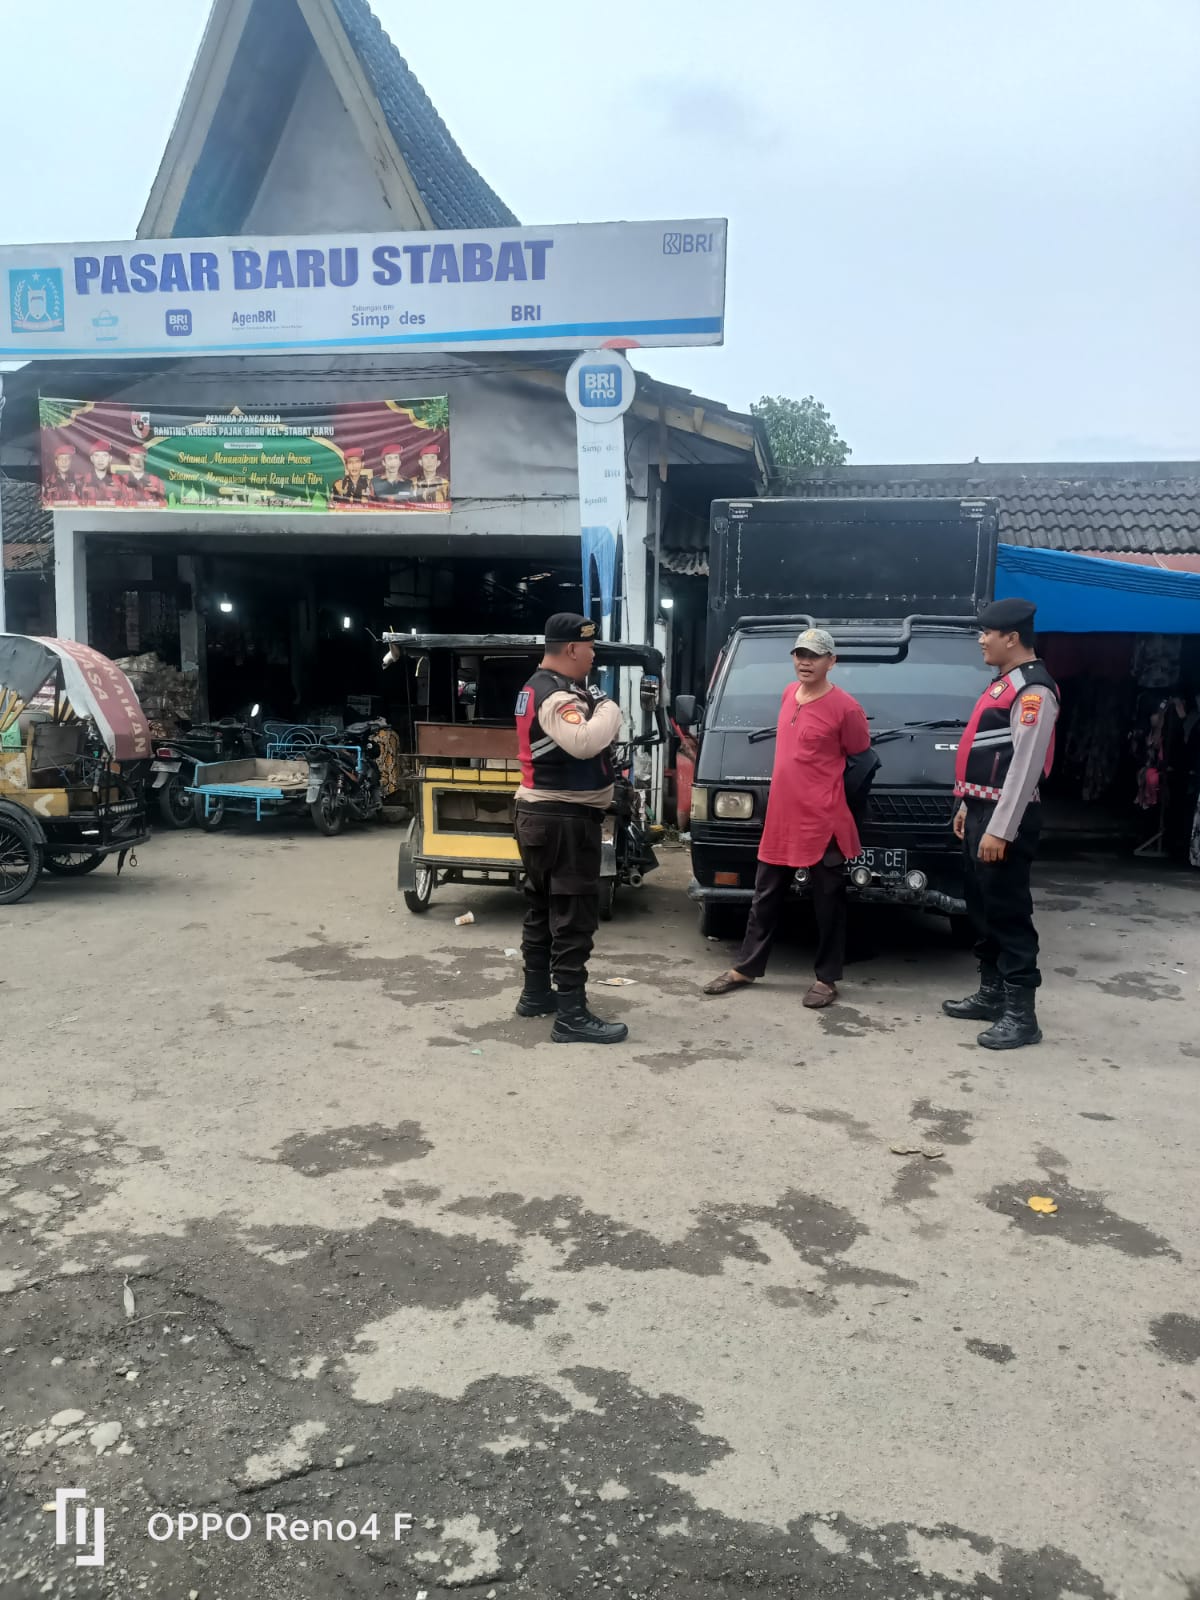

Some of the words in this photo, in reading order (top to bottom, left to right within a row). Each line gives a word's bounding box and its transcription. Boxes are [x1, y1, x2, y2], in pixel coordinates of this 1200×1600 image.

[682, 234, 713, 253] BRI
[74, 252, 220, 295] PASAR
[232, 246, 359, 290] BARU
[372, 240, 554, 286] STABAT
[169, 314, 188, 325] BRI
[232, 310, 276, 327] AgenBRI
[351, 312, 390, 329] Simp
[399, 311, 426, 325] des
[511, 305, 541, 322] BRI
[172, 324, 188, 332] mo
[584, 372, 615, 389] BRI
[590, 389, 616, 399] mo
[205, 414, 236, 423] PEMUDA
[238, 414, 281, 423] PANCASILA
[153, 426, 186, 436] RANTING
[188, 426, 217, 436] KHUSUS
[218, 426, 243, 436] PAJAK
[244, 426, 265, 436] BARU
[284, 426, 312, 436] STABAT
[313, 426, 334, 436] BARU
[884, 850, 903, 867] CE
